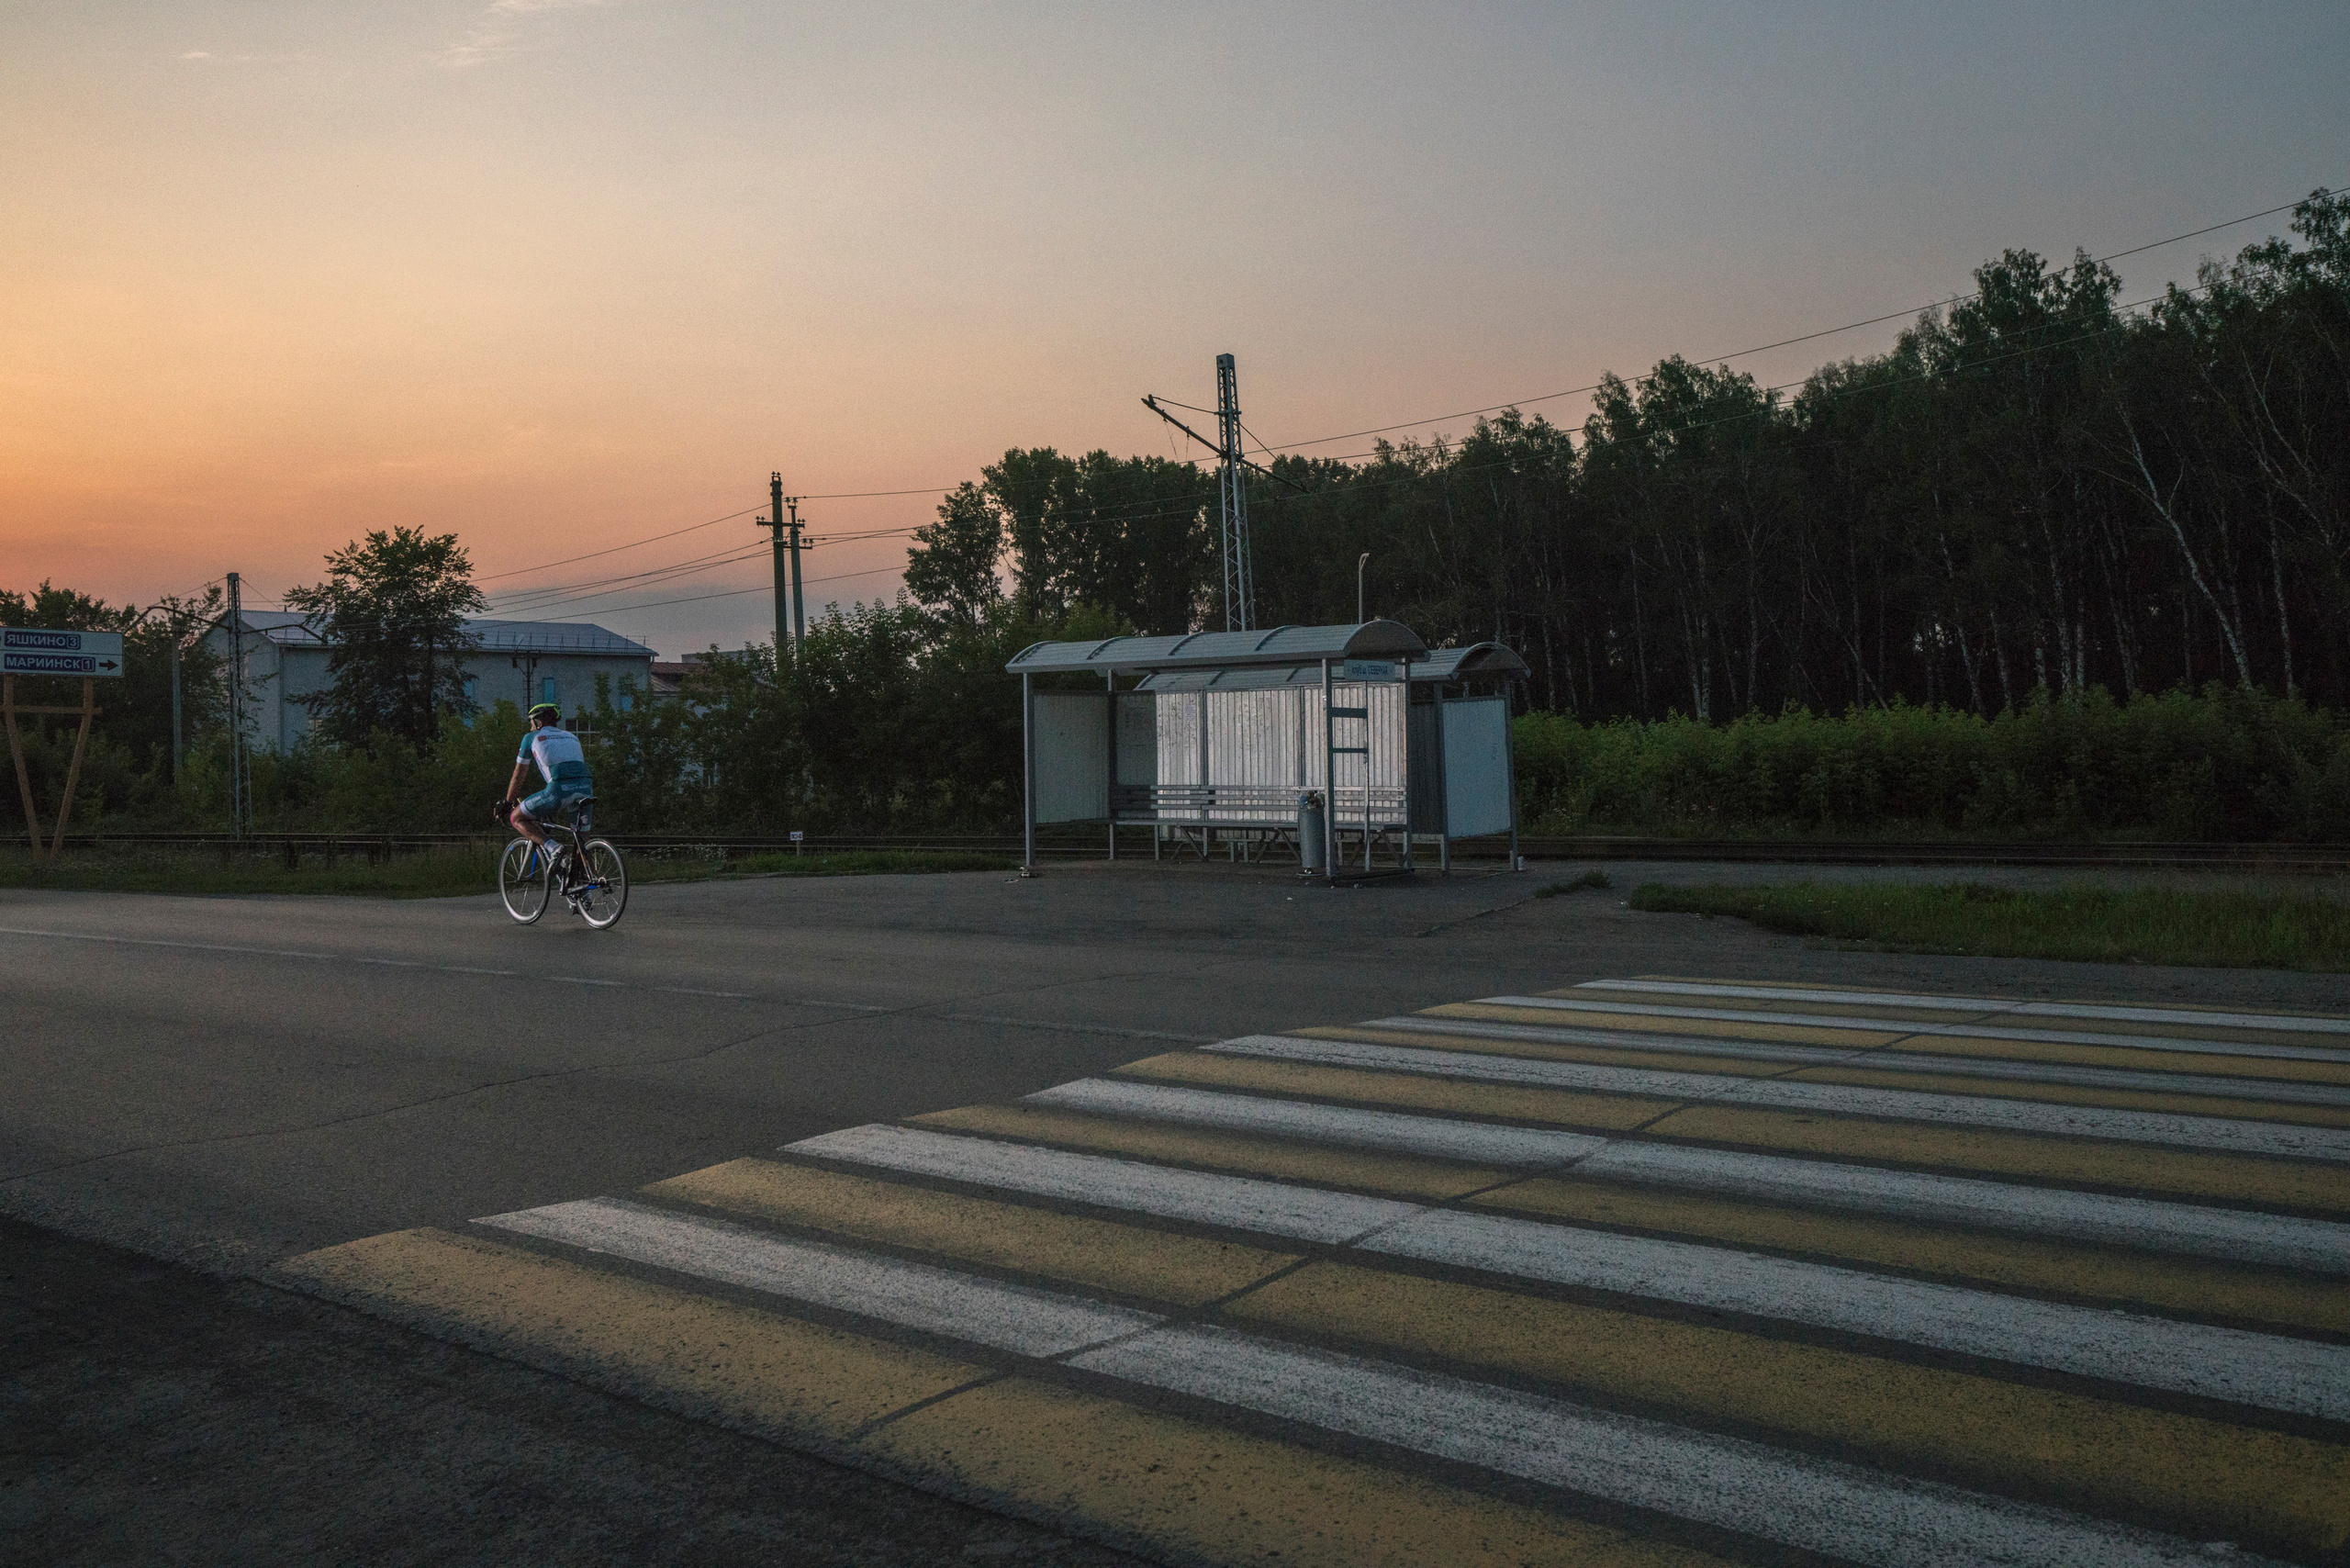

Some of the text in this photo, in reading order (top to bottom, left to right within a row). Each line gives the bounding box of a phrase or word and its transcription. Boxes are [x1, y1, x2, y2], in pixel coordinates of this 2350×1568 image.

[6, 633, 77, 646] ЯШКИНО 3
[6, 656, 80, 669] МАРИИНСК
